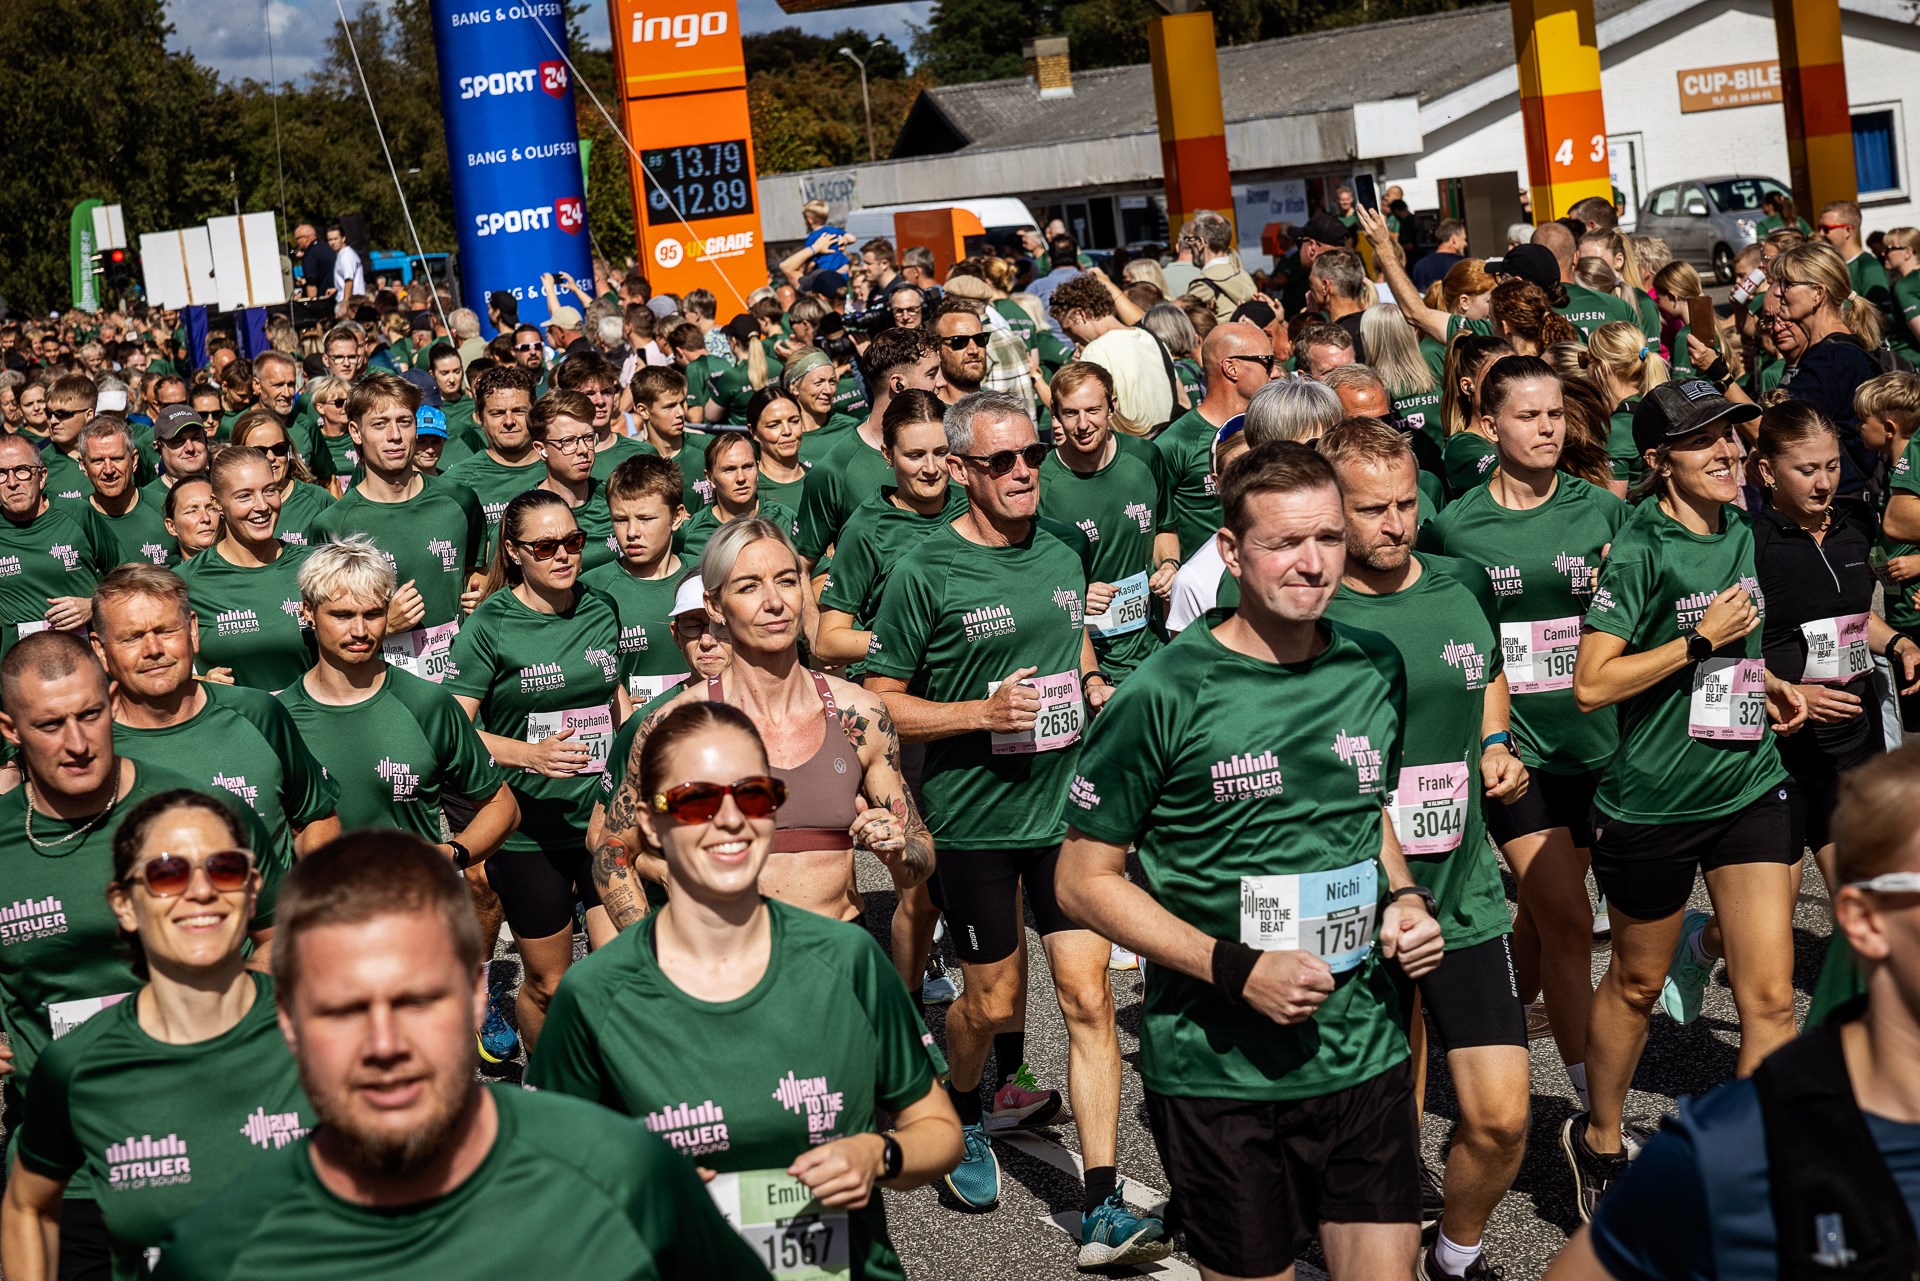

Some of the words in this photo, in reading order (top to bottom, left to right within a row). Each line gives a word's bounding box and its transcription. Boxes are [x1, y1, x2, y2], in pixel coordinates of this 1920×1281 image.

[451, 9, 491, 27] BANG
[495, 8, 506, 22] &
[632, 11, 728, 48] ingo
[459, 69, 537, 100] SPORT
[543, 66, 568, 89] 24
[467, 149, 507, 167] BANG
[511, 148, 522, 161] &
[524, 141, 577, 160] OLUFSEN
[1554, 138, 1574, 166] 4
[1590, 134, 1605, 163] 3
[670, 142, 741, 180] 13.79
[672, 178, 747, 216] 12.89
[475, 206, 553, 237] SPORT
[559, 202, 583, 226] 24
[660, 244, 677, 261] 95
[527, 285, 538, 299] &
[440, 540, 452, 549] RUN
[442, 548, 449, 557] TO
[449, 548, 457, 556] THE
[443, 557, 456, 566] BEAT
[1569, 556, 1585, 566] RUN
[1570, 567, 1580, 577] TO
[1580, 566, 1593, 577] THE
[1118, 582, 1142, 597] Kasper
[1572, 576, 1588, 588] BEAT
[1500, 588, 1524, 597] SOUND
[1118, 600, 1148, 624] 2564
[217, 619, 260, 632] STRUER
[232, 628, 239, 636] OF
[241, 626, 260, 634] SOUND
[966, 618, 1016, 636] STRUER
[421, 629, 454, 646] Frederik
[968, 634, 982, 642] CITY
[984, 632, 993, 640] OF
[995, 628, 1016, 638] SOUND
[1504, 638, 1518, 646] RUN
[1817, 632, 1828, 641] RUN
[393, 645, 404, 654] RUN
[1458, 642, 1476, 656] RUN
[1506, 646, 1514, 654] TO
[1516, 645, 1528, 654] THE
[1818, 642, 1824, 650] TO
[1825, 640, 1835, 649] THE
[402, 650, 410, 658] THE
[1461, 656, 1472, 668] TO
[1472, 654, 1484, 666] THE
[1506, 654, 1524, 662] BEAT
[1818, 650, 1832, 658] BEAT
[396, 658, 408, 666] BEAT
[520, 674, 565, 688] STRUER
[1465, 667, 1482, 681] BEAT
[1706, 674, 1720, 684] RUN
[520, 686, 535, 694] CITY
[546, 682, 566, 690] SOUND
[1042, 682, 1073, 699] Jørgen
[1706, 684, 1714, 693] TO
[1716, 684, 1728, 694] THE
[1706, 694, 1724, 702] BEAT
[566, 713, 610, 730] Stephanie
[1040, 710, 1078, 738] 2636
[1350, 736, 1370, 751] RUN
[1354, 750, 1366, 765] TO
[1366, 748, 1382, 764] THE
[392, 763, 410, 774] RUN
[1358, 766, 1380, 782] BEAT
[394, 774, 404, 785] TO
[404, 774, 420, 785] THE
[1212, 770, 1282, 795] STRUER
[1418, 774, 1454, 792] Frank
[394, 784, 414, 796] BEAT
[1214, 792, 1236, 803] CITY
[1238, 790, 1252, 800] OF
[1254, 785, 1284, 798] SOUND
[1412, 808, 1461, 838] 3044
[1326, 876, 1360, 901] Nichi
[1259, 898, 1279, 908] RUN
[1260, 909, 1271, 920] TO
[1272, 908, 1291, 920] THE
[0, 912, 67, 938] STRUER
[1260, 921, 1284, 932] BEAT
[21, 934, 34, 944] OF
[36, 926, 68, 940] SOUND
[966, 924, 980, 951] FUSION
[1316, 916, 1368, 956] 1757
[800, 1076, 827, 1097] RUN
[804, 1096, 822, 1114] TO
[822, 1091, 843, 1112] THE
[268, 1112, 300, 1133] RUN
[808, 1112, 837, 1132] BEAT
[692, 1140, 730, 1156] SOUND
[108, 1157, 190, 1184] STRUER
[132, 1177, 148, 1190] OF
[151, 1172, 192, 1188] SOUND
[763, 1226, 833, 1271] 1567
